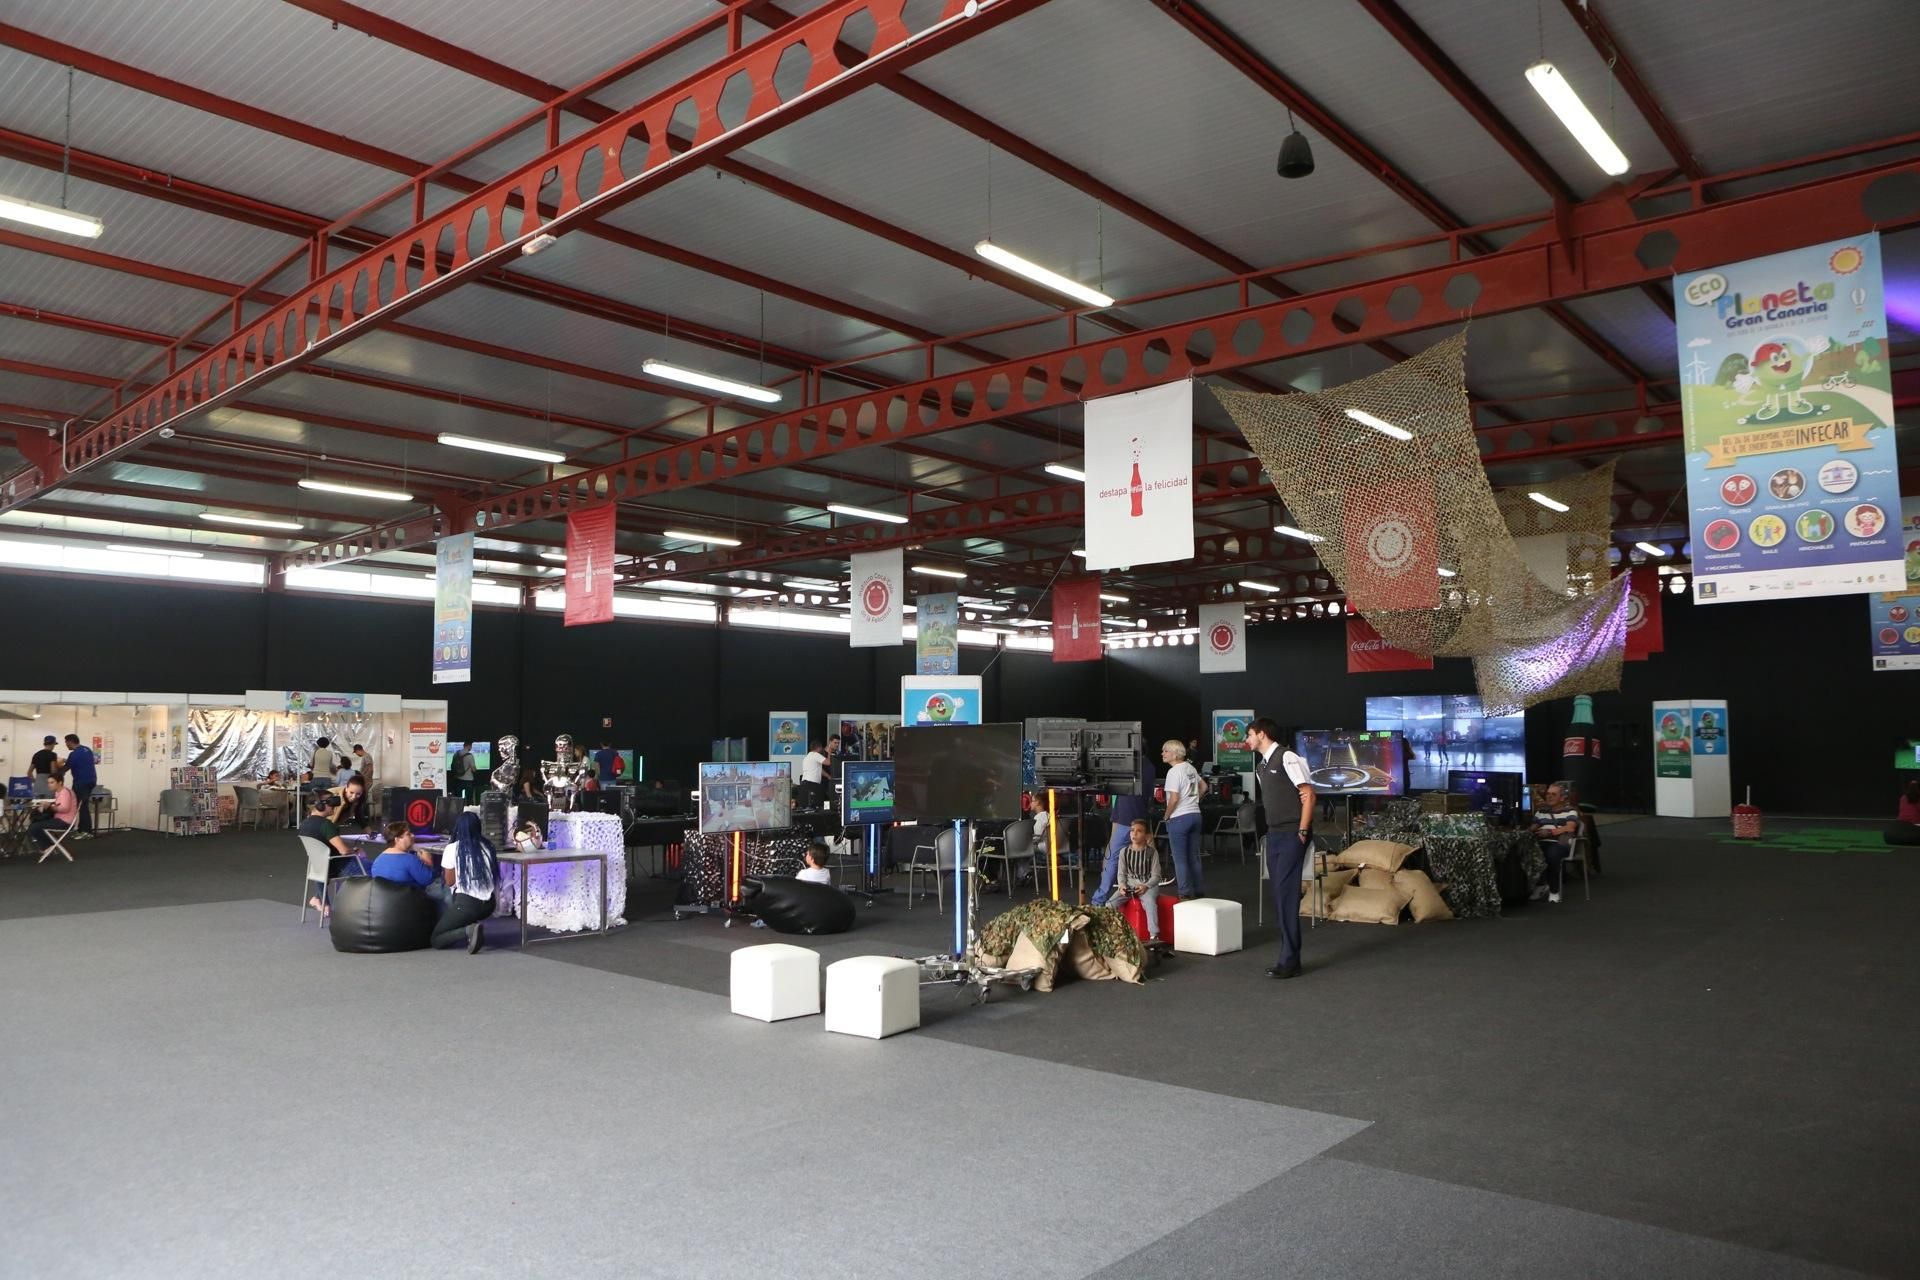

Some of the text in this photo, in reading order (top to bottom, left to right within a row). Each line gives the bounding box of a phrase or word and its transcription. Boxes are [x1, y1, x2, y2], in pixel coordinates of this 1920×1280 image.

[1688, 278, 1721, 300] ECO
[1717, 281, 1835, 319] Planeta
[1726, 316, 1763, 329] Gran
[1766, 302, 1828, 320] Canaria
[1795, 421, 1849, 446] INFECAR
[1099, 487, 1128, 499] destapa
[1145, 482, 1152, 491] la
[1154, 476, 1188, 489] felicidad
[1350, 639, 1380, 652] Coca-Cola
